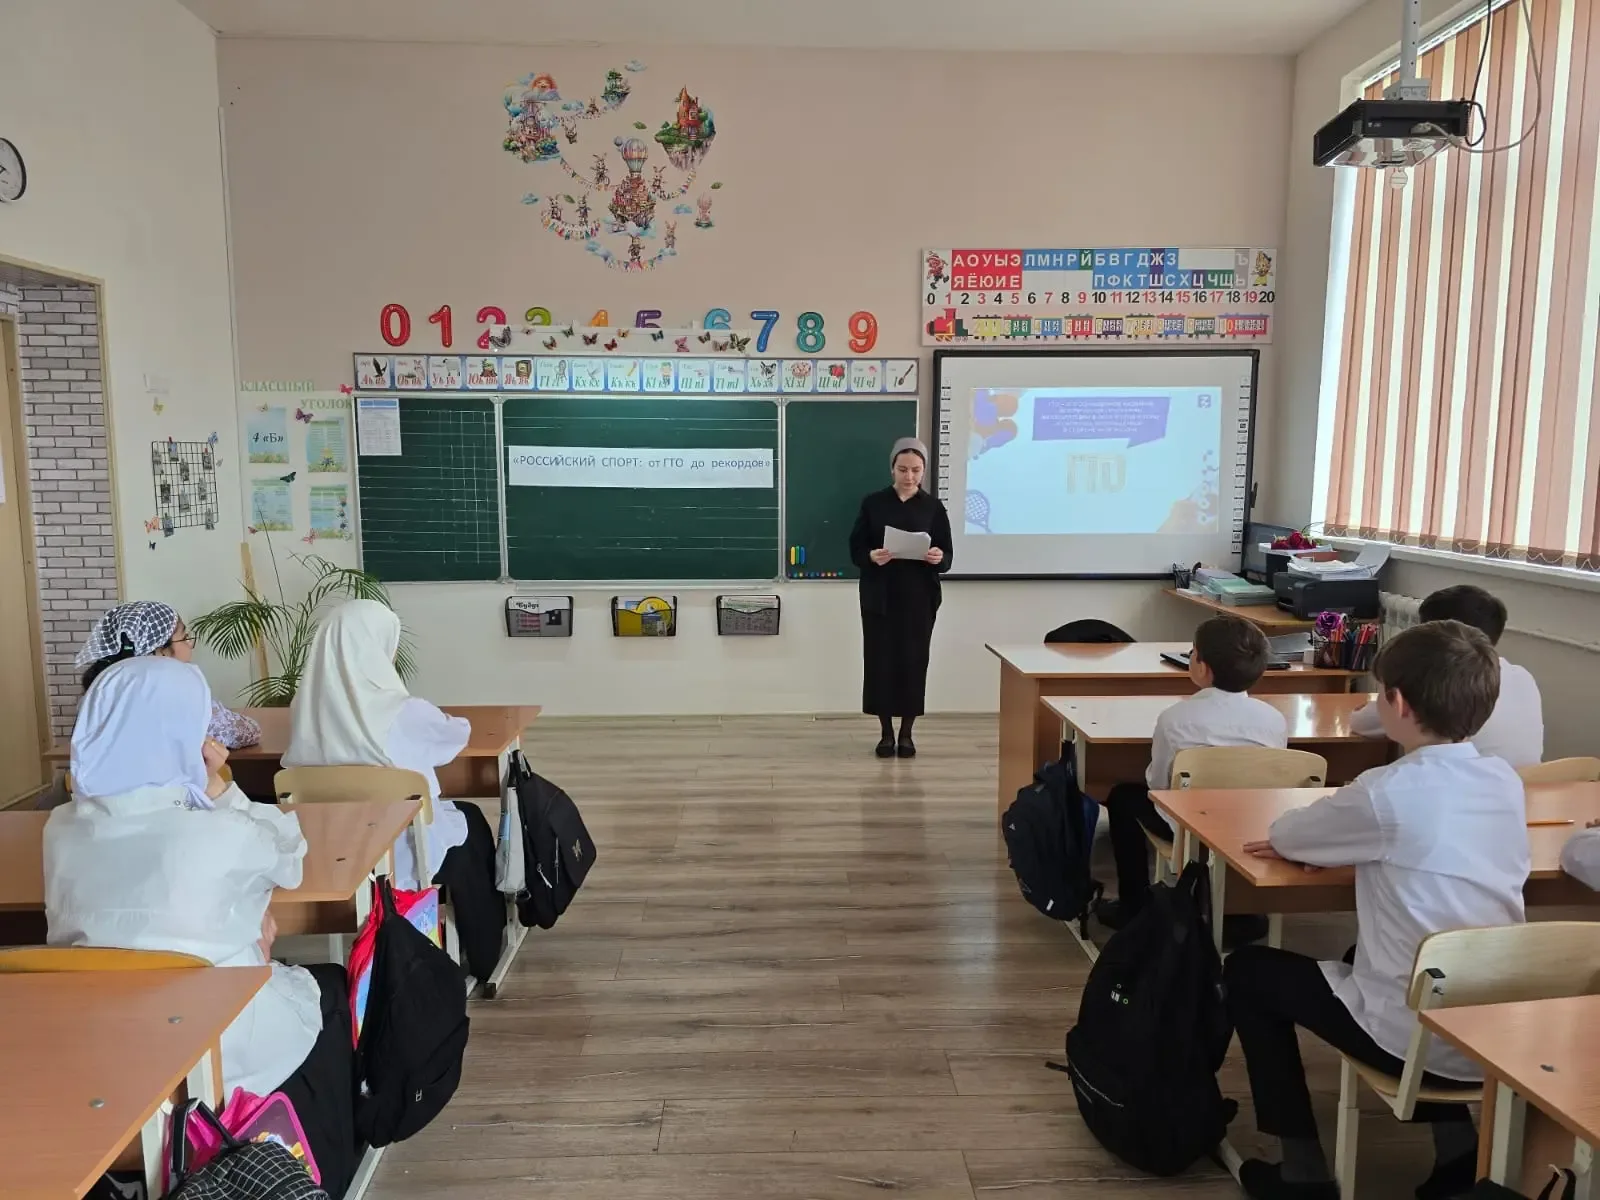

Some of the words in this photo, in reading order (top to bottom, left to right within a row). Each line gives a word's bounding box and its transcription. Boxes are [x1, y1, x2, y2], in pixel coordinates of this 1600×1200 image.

[927, 292, 935, 305] 0
[945, 292, 951, 305] 1
[961, 292, 969, 305] 2
[977, 292, 986, 305] 3
[994, 292, 1003, 305] 4
[1011, 292, 1019, 305] 5
[1028, 292, 1036, 305] 6
[1044, 292, 1053, 305] 7
[1061, 292, 1070, 305] 8
[1078, 292, 1087, 305] 9
[1092, 291, 1106, 303] 10
[1111, 291, 1122, 303] 11
[1125, 291, 1140, 303] 12
[1142, 291, 1156, 303] 13
[1159, 291, 1174, 303] 14
[1176, 291, 1190, 303] 15
[1193, 291, 1207, 303] 16
[1210, 291, 1224, 303] 17
[1227, 291, 1240, 303] 18
[1244, 291, 1257, 303] 19
[1258, 291, 1275, 303] 20
[380, 303, 411, 346] 0
[429, 304, 453, 348] 1
[751, 310, 779, 352] 7
[796, 311, 825, 353] 8
[848, 311, 878, 353] 9
[252, 433, 259, 443] 4
[263, 433, 284, 443] «Б»
[513, 454, 596, 467] «РОССИЙСКИЙ
[601, 456, 642, 468] СПОРТ:
[648, 459, 660, 468] от
[663, 457, 684, 468] ГТО
[690, 459, 705, 470] до
[711, 459, 770, 470] рекордов»
